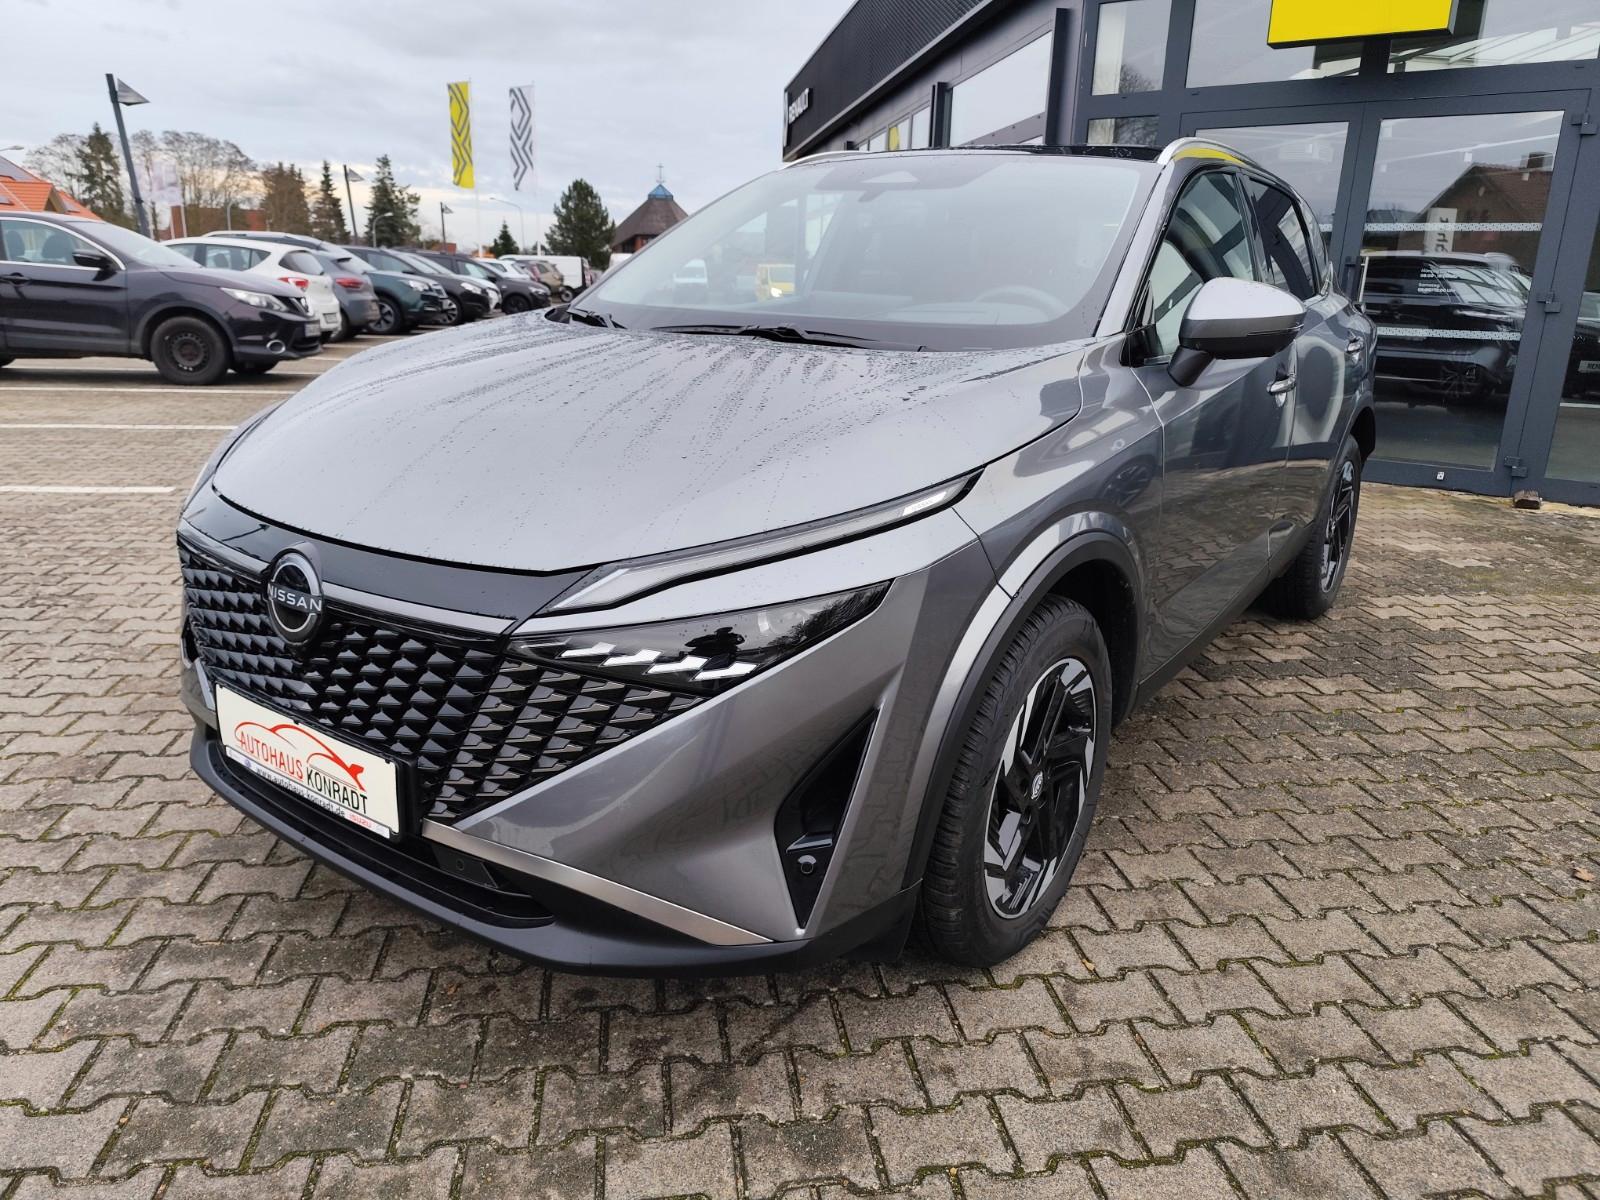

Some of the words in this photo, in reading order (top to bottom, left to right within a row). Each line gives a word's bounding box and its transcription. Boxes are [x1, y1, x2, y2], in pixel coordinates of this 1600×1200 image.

[267, 582, 322, 612] NISSAN
[240, 731, 304, 780] AUTOHAUS
[306, 766, 368, 814] KONRADT
